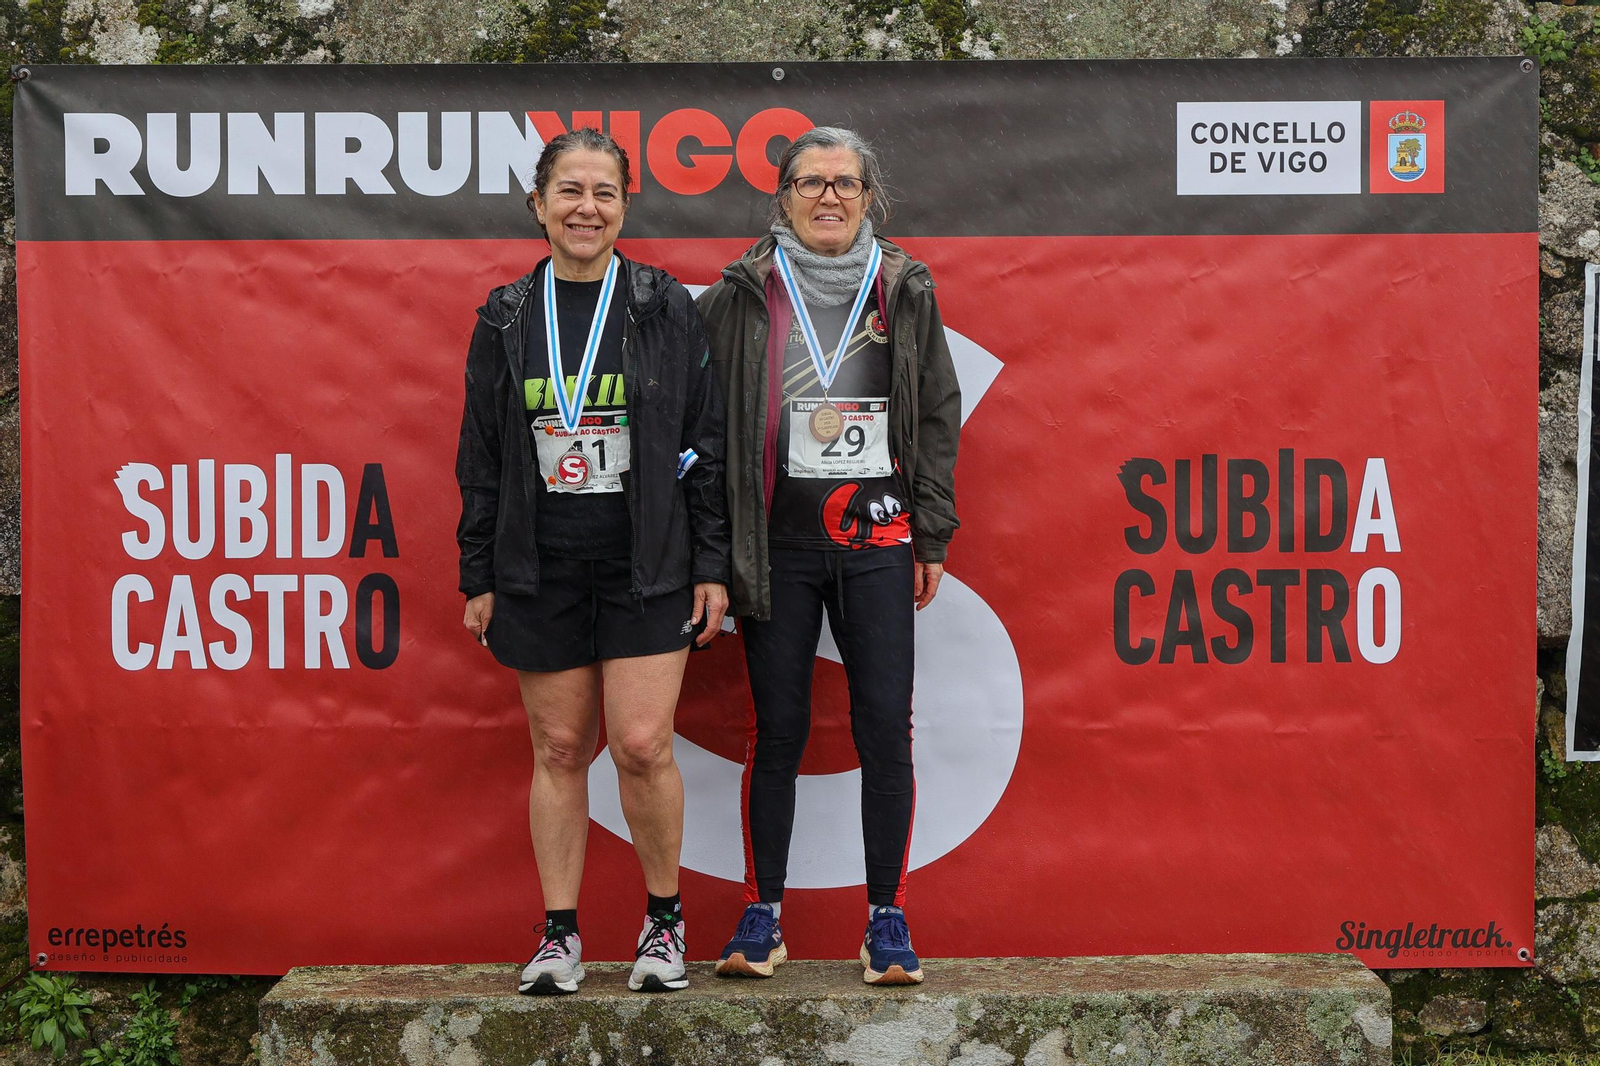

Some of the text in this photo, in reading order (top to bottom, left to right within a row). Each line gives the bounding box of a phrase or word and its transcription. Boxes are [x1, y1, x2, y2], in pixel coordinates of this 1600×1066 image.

[1191, 121, 1346, 144] CONCELLO
[1209, 150, 1328, 174] DE VIGO
[580, 428, 591, 436] AO
[591, 427, 621, 436] CASTRO
[848, 414, 875, 422] CASTRO
[821, 425, 866, 458] 29
[113, 453, 400, 560] SUBIDA
[1116, 448, 1402, 555] SUBIDA
[111, 573, 400, 671] CASTRO
[1113, 567, 1402, 665] CASTRO
[47, 922, 188, 953] errepetrés
[1335, 920, 1513, 959] Singletrack.
[49, 952, 97, 962] deseño
[116, 953, 188, 964] publicidade
[1402, 949, 1513, 959] Outdoor sports
